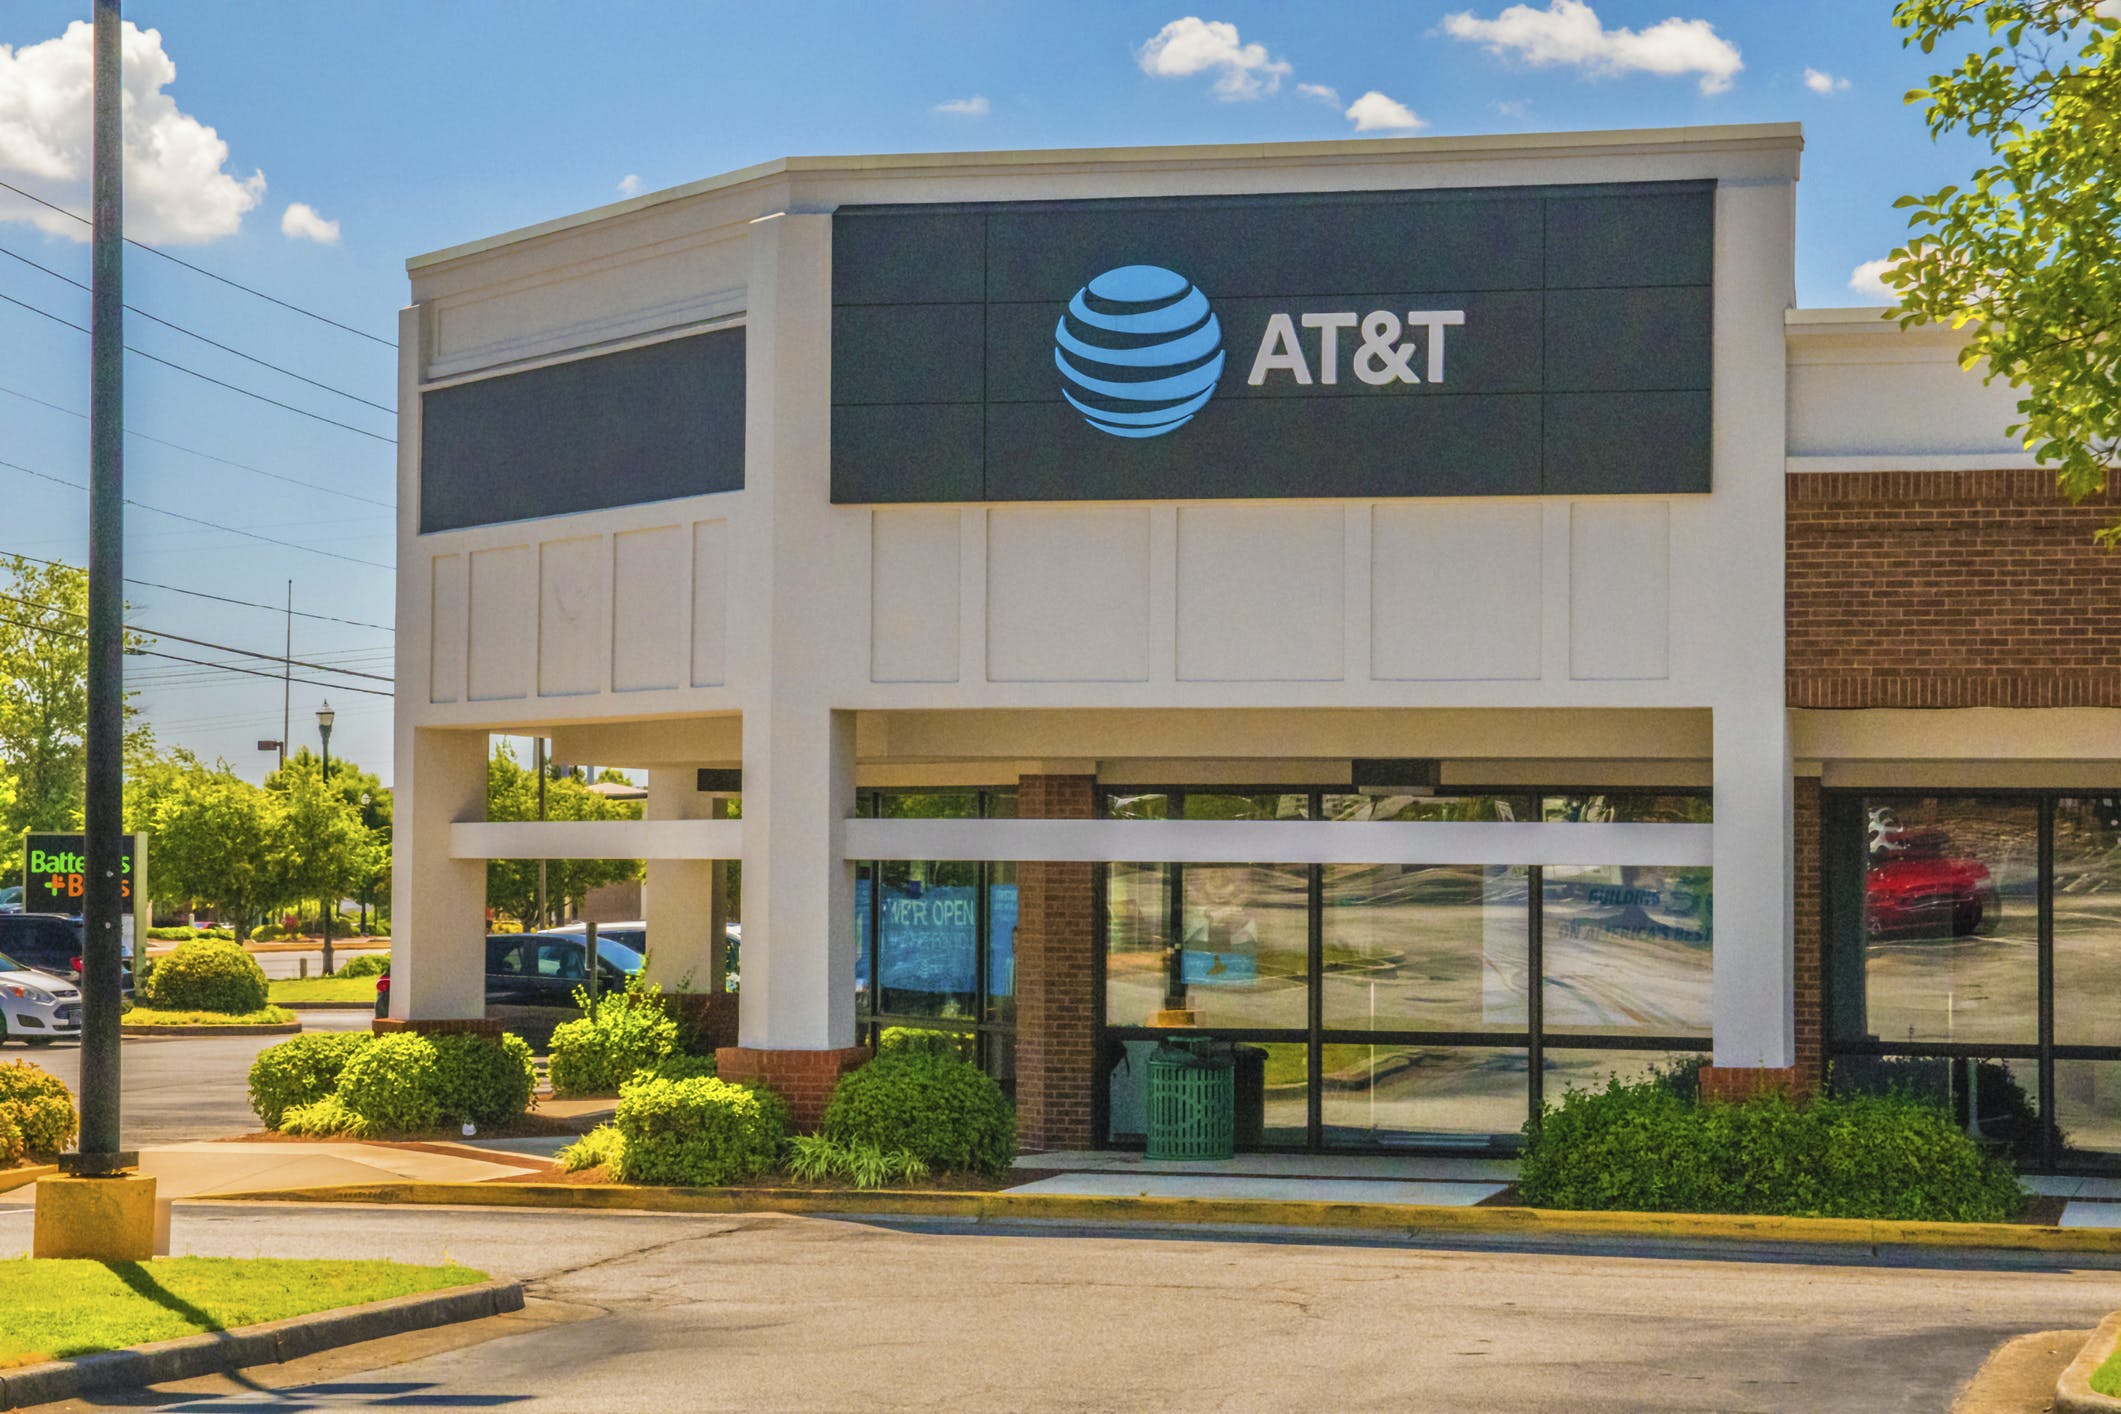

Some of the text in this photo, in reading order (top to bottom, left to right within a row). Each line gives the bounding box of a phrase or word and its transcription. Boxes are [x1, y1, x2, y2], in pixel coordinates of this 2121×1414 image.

[1248, 309, 1466, 386] AT&T
[31, 850, 131, 873] Battes
[932, 899, 975, 926] OPEN
